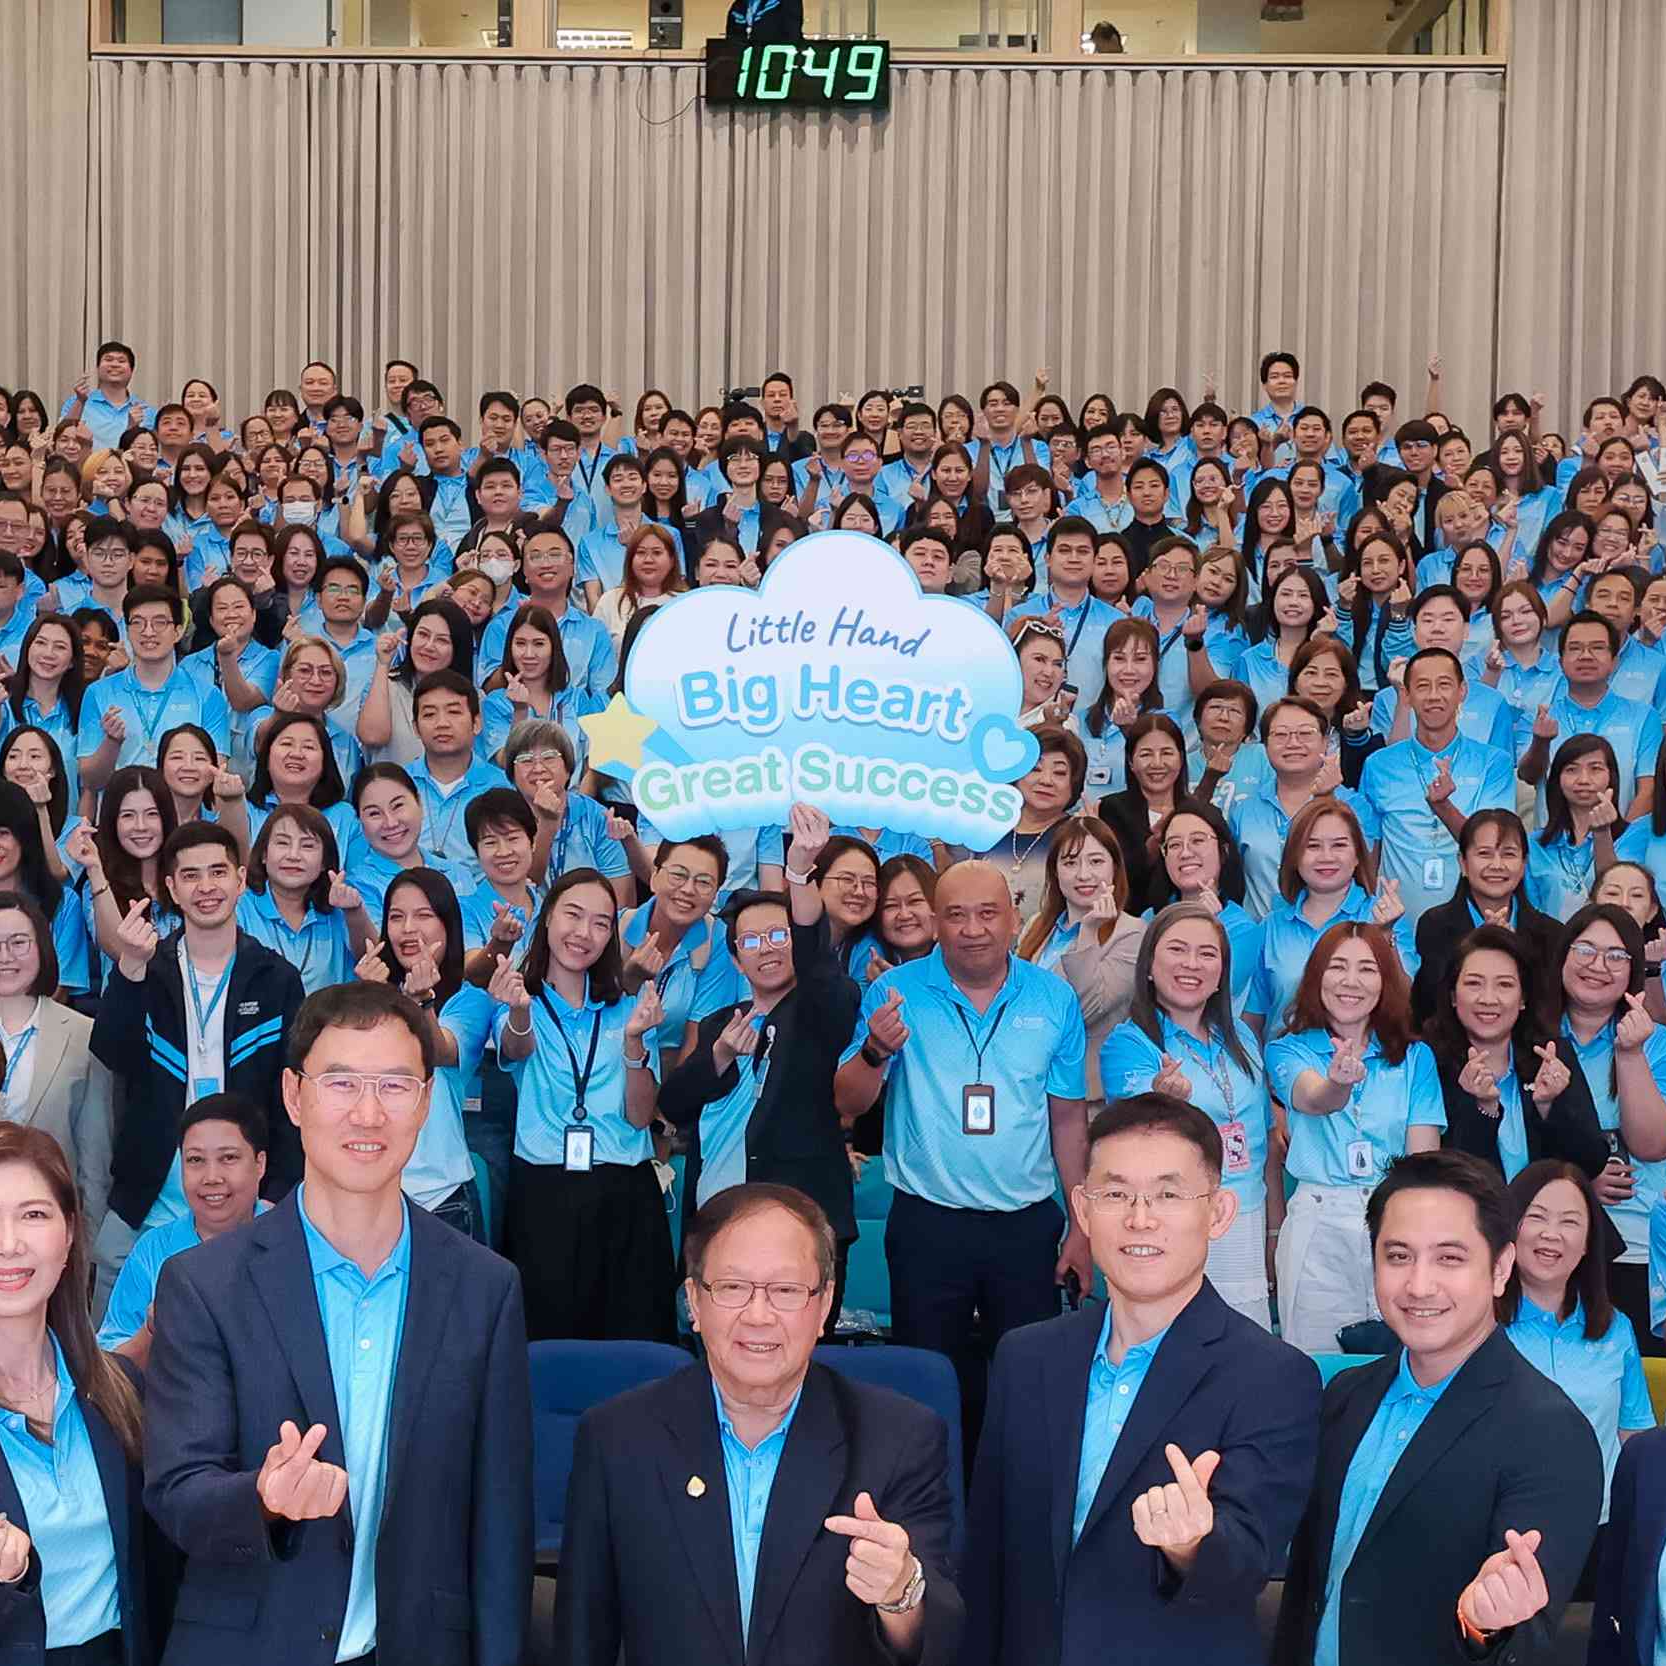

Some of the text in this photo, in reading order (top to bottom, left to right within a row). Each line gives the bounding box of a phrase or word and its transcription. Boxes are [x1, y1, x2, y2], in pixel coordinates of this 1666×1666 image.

[726, 606, 932, 657] Little Hand
[680, 664, 966, 733] Big Heart
[638, 749, 1018, 823] Great Success
